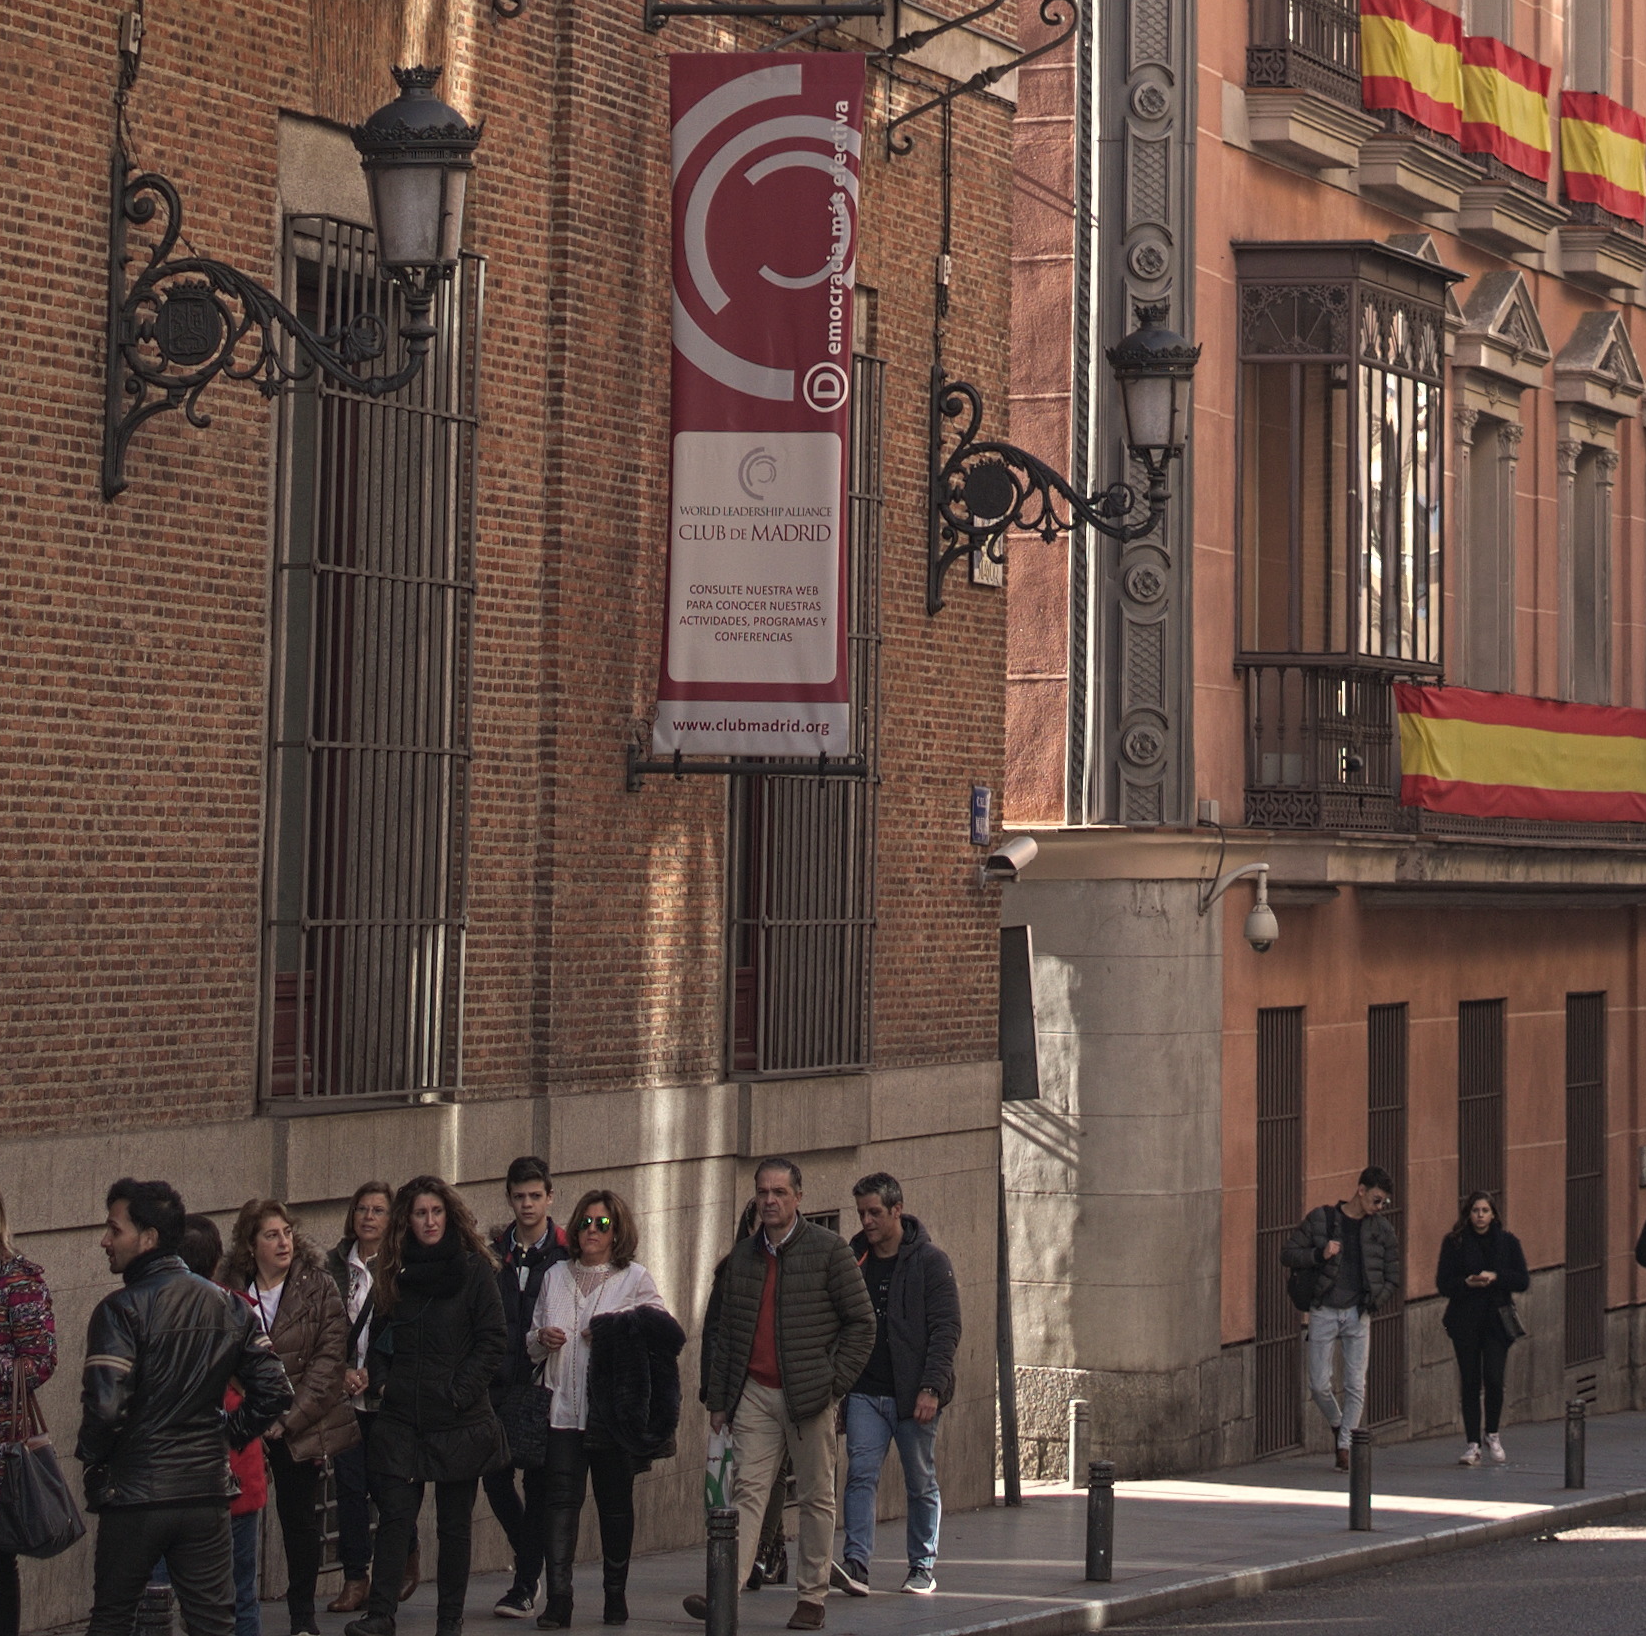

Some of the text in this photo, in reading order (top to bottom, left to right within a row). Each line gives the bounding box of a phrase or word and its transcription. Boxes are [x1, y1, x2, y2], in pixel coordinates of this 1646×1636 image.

[831, 100, 849, 187] efectiva
[827, 191, 846, 236] más
[680, 506, 832, 517] WORLD LEADERSHIP ALLIANCE
[678, 524, 726, 541] CLUB
[751, 524, 831, 542] MADRID
[689, 584, 819, 595] CONSULTE NUESTRA WEB
[686, 600, 821, 611] PARA CONOCER NUESTRAS
[679, 616, 827, 627] ACTIVIDADES, PROGRAMAS Y
[714, 631, 793, 642] CONFERENCIAS
[672, 718, 830, 736] www.clubmadrid.org
